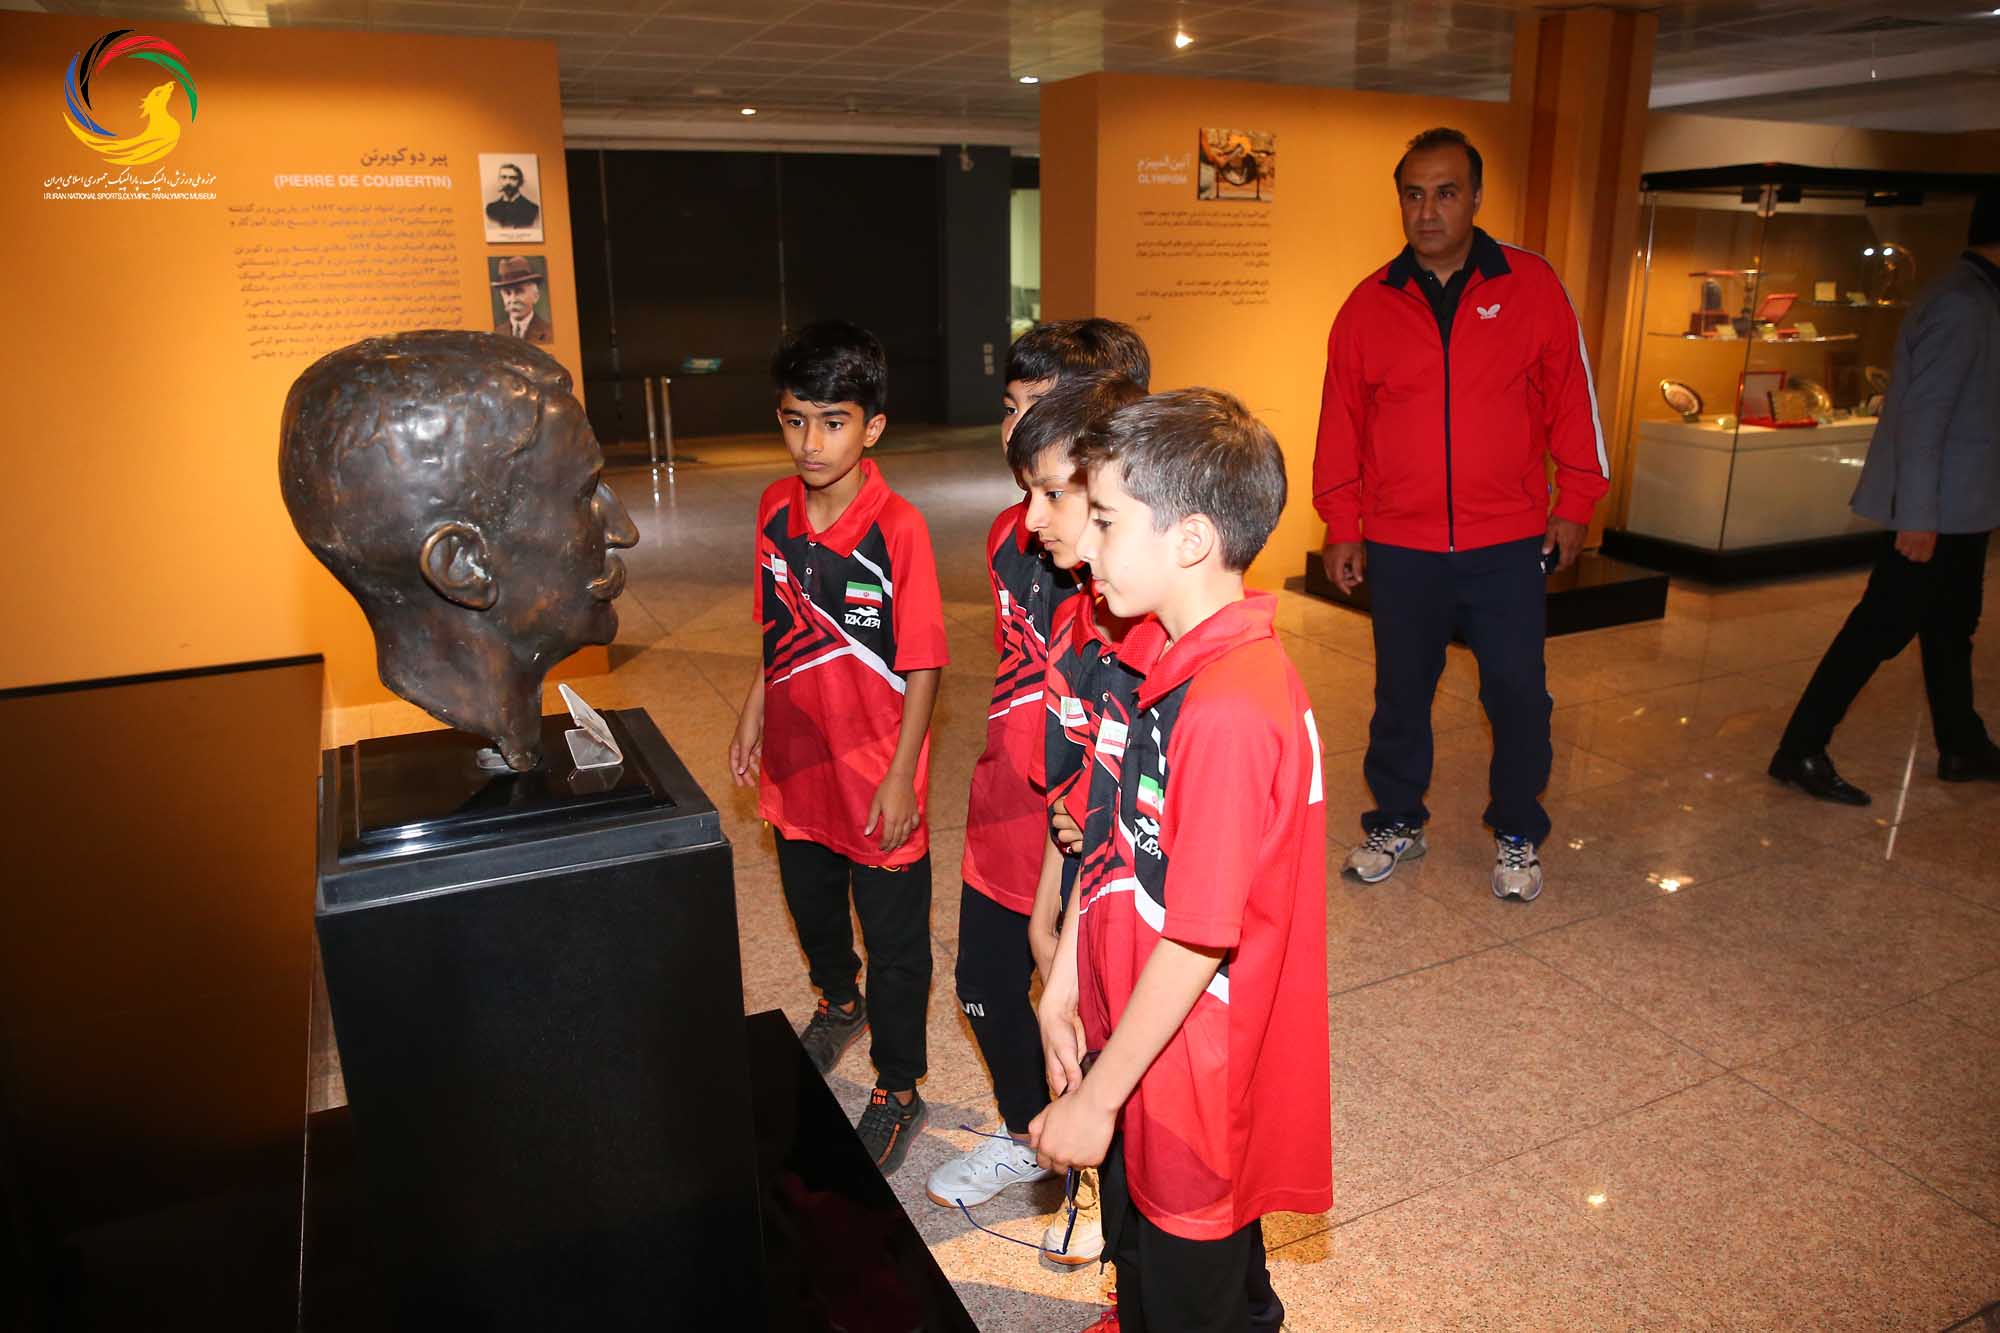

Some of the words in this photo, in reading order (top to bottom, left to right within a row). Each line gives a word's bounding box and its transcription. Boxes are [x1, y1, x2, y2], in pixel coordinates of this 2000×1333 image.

[360, 147, 408, 167] کوبرتن
[410, 151, 426, 166] دو
[429, 151, 448, 167] پیر
[274, 174, 335, 190] (PIERRE
[339, 174, 359, 188] DE
[362, 174, 453, 190] COUBERTIN)
